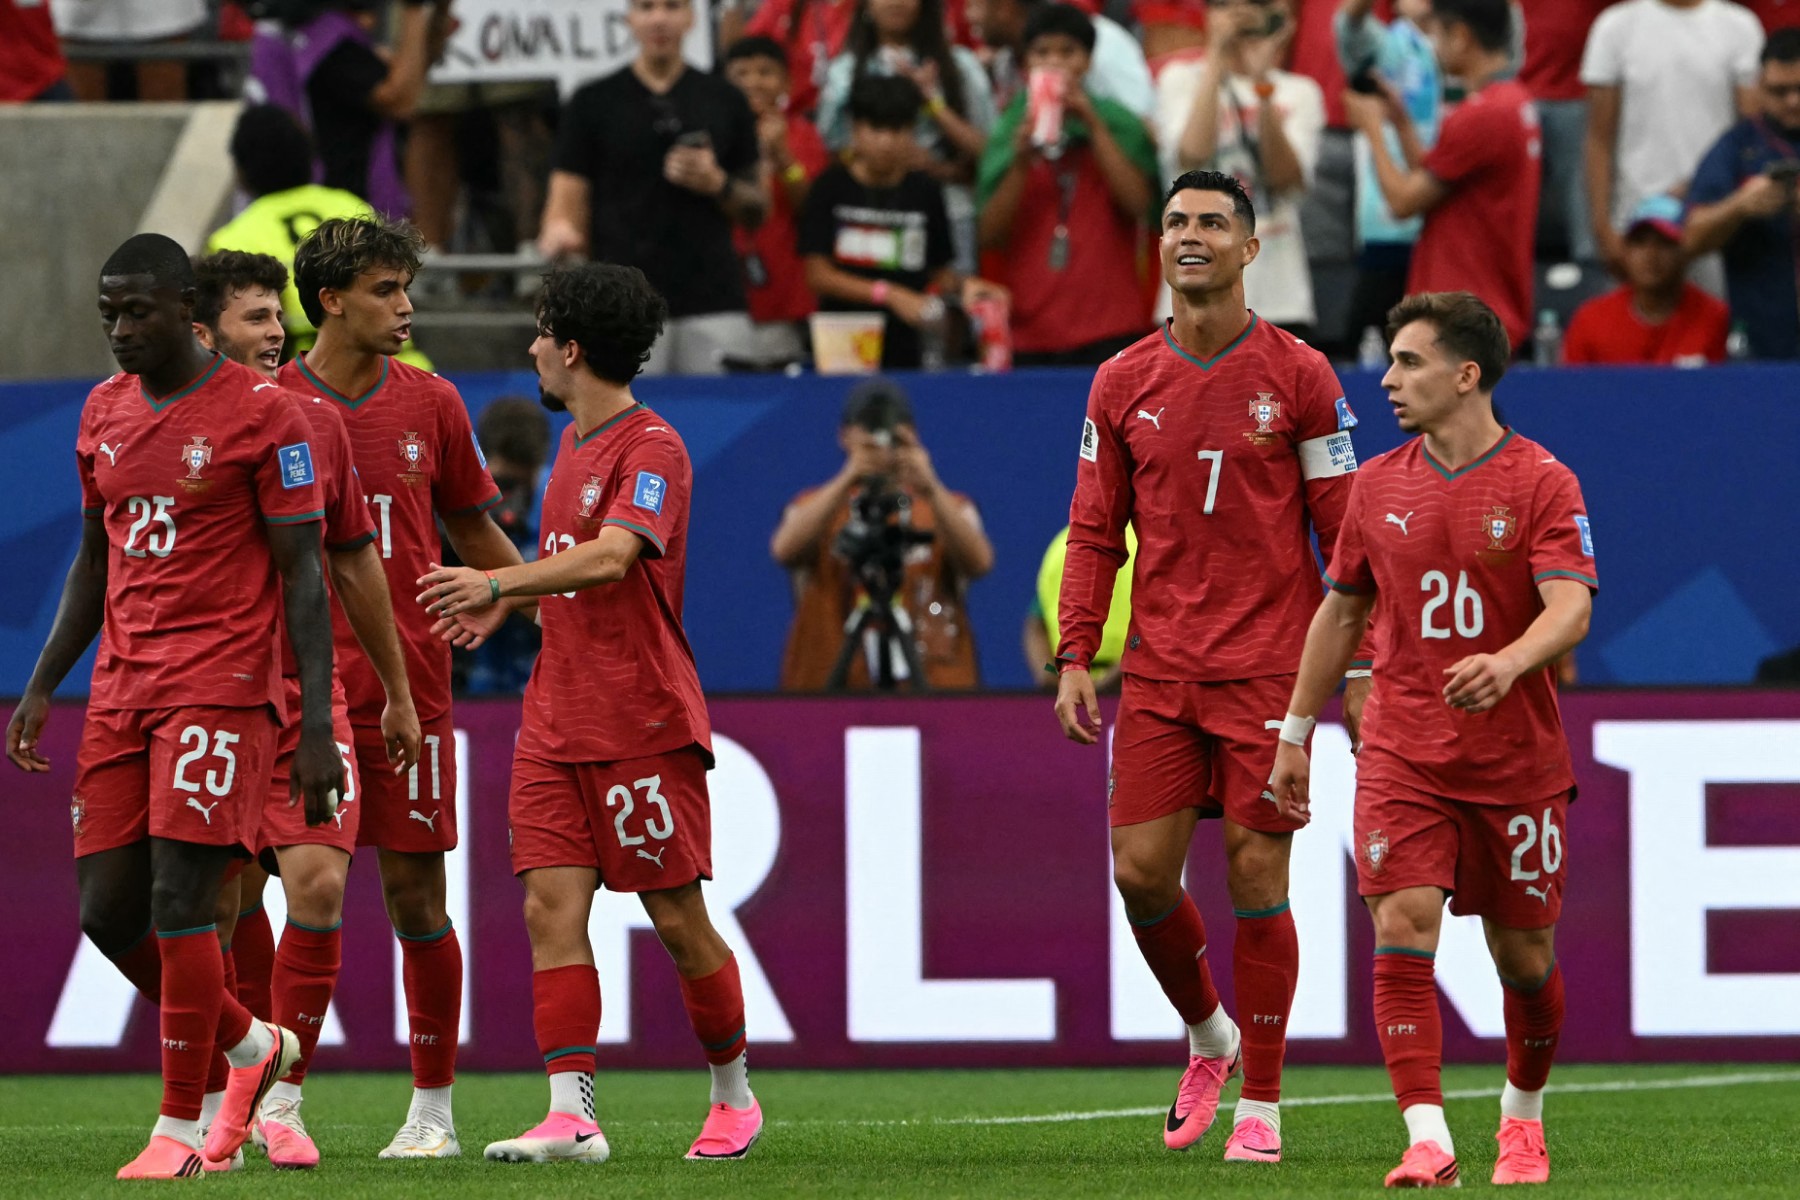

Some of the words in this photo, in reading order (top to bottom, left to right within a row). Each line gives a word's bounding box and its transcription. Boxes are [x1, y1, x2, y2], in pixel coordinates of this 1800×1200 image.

[432, 10, 634, 68] ONALD
[1197, 450, 1223, 515] 7
[1329, 443, 1354, 456] UNITE
[124, 496, 176, 558] 25
[363, 493, 393, 559] 1
[1420, 569, 1484, 639] 26
[172, 725, 240, 797] 25
[335, 741, 355, 802] 5
[606, 774, 675, 848] 23
[1507, 807, 1562, 881] 26
[44, 719, 1800, 1048] RLNE
